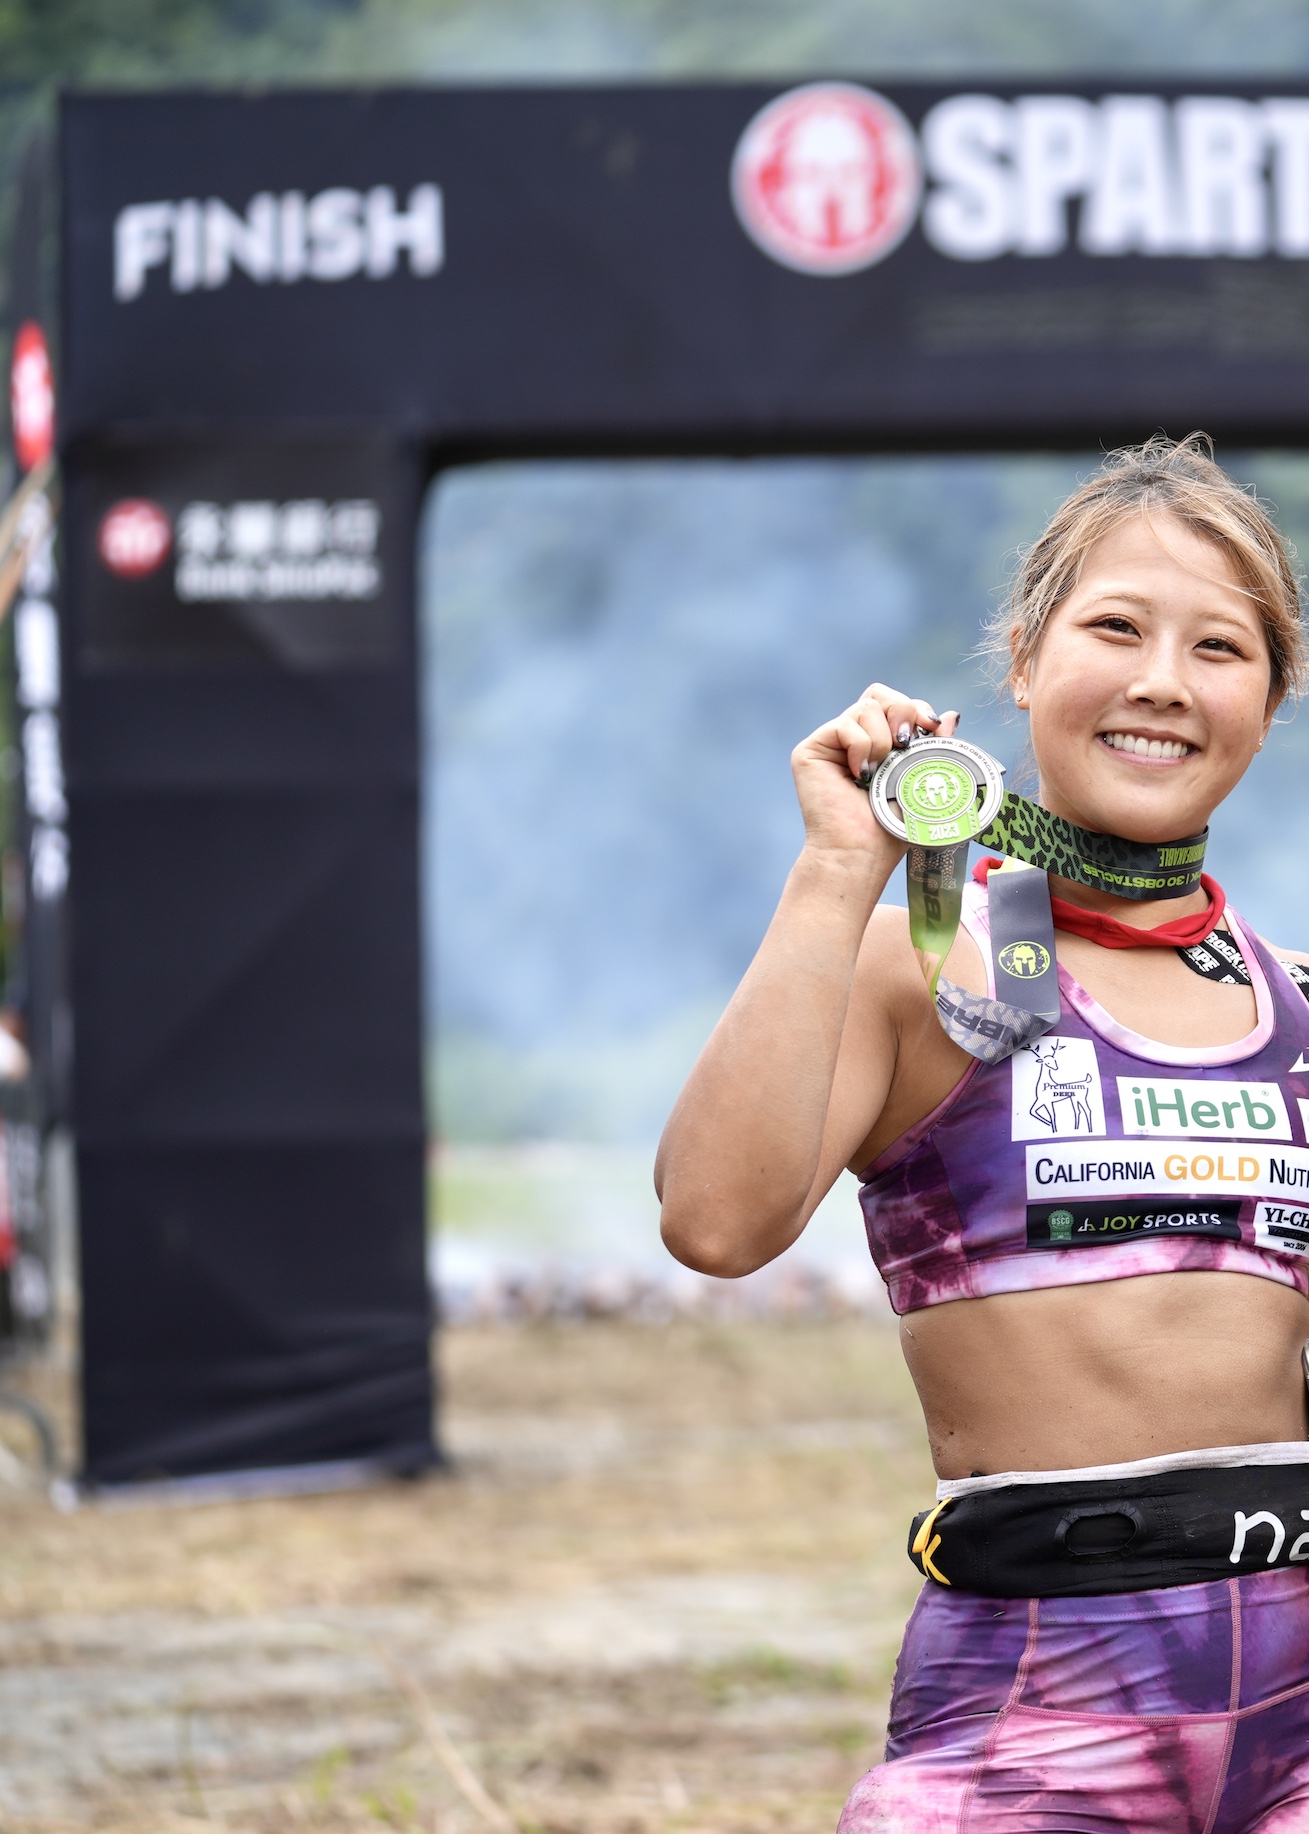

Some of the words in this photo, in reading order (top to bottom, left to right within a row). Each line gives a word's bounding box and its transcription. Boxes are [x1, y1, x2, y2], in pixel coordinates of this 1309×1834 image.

[114, 183, 445, 302] FINISH
[928, 821, 960, 841] 2023
[1082, 863, 1165, 889] OBSTACLES
[1167, 877, 1186, 887] 30
[1042, 1082, 1086, 1092] Premium
[1131, 1086, 1276, 1131] iHerb
[1034, 1157, 1155, 1184] CALIFORNIA
[1163, 1154, 1260, 1181] GOLD
[1051, 1217, 1070, 1225] BSCG
[1099, 1215, 1140, 1231] JOY
[1143, 1212, 1222, 1228] SPORTS
